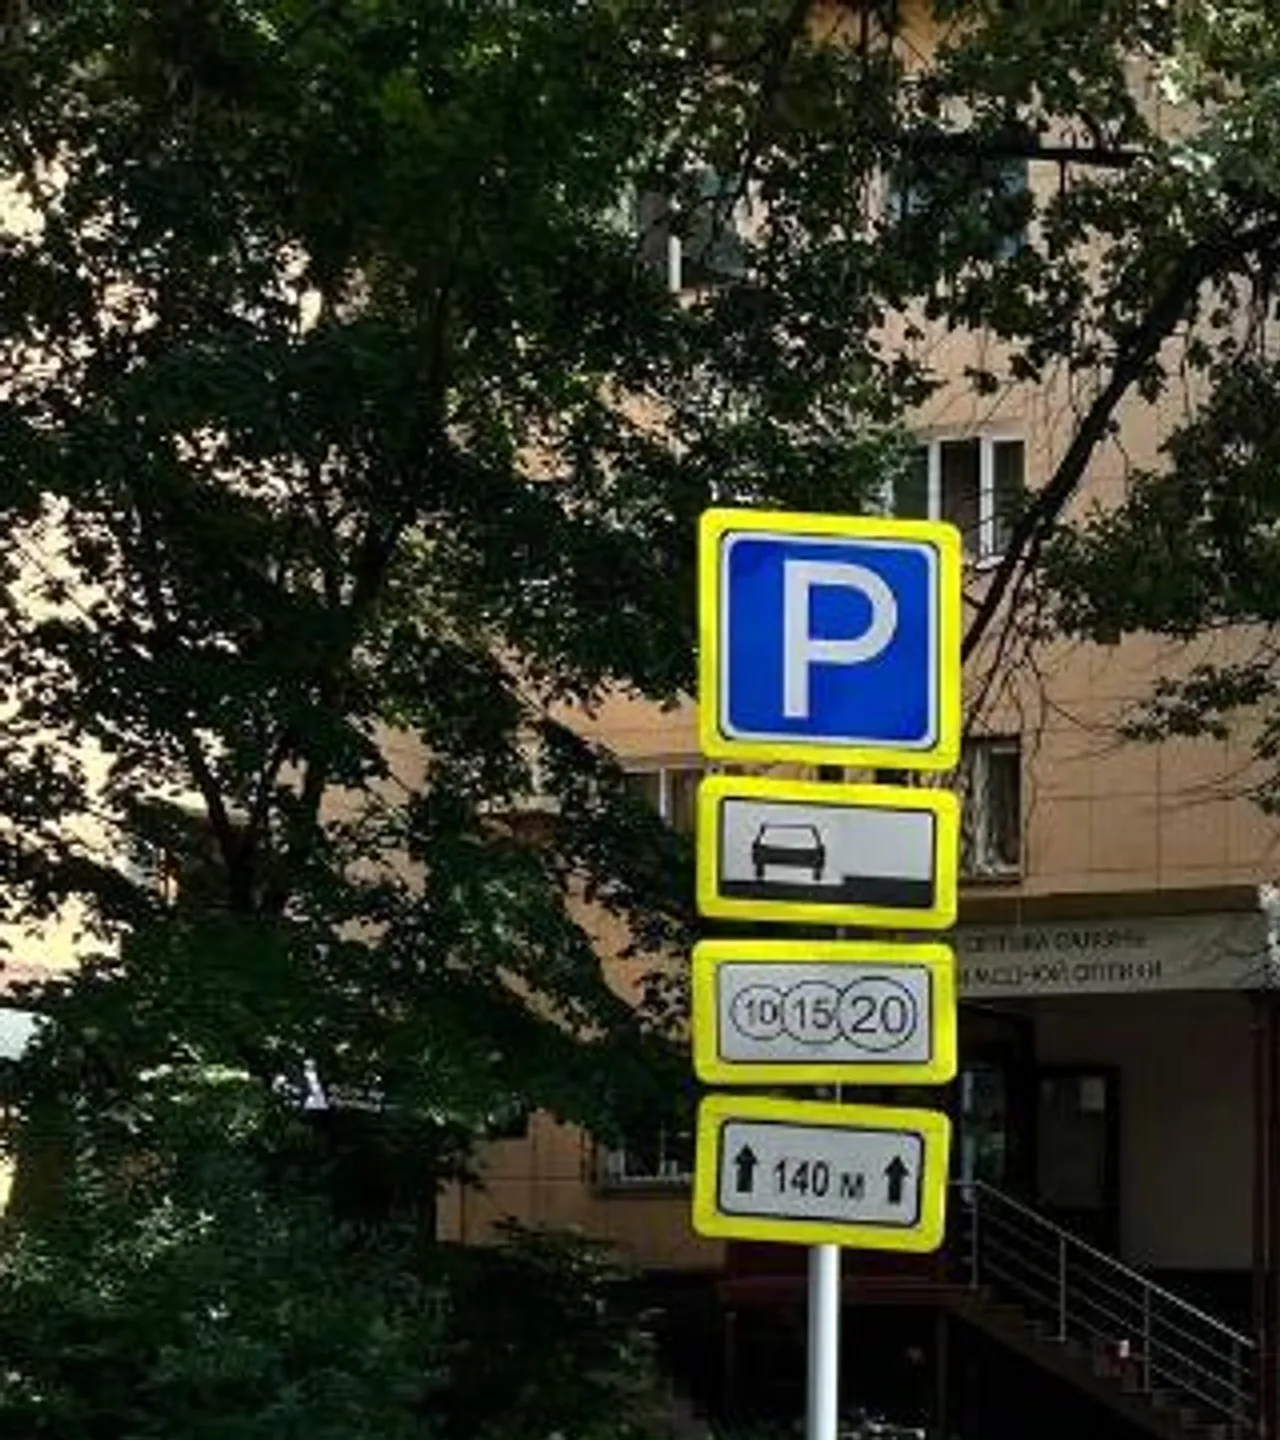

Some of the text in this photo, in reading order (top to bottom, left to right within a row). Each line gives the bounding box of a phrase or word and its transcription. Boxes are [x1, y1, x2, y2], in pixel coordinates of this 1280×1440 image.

[782, 558, 899, 719] P
[743, 995, 909, 1034] 10 15 20
[774, 1159, 830, 1198] 140
